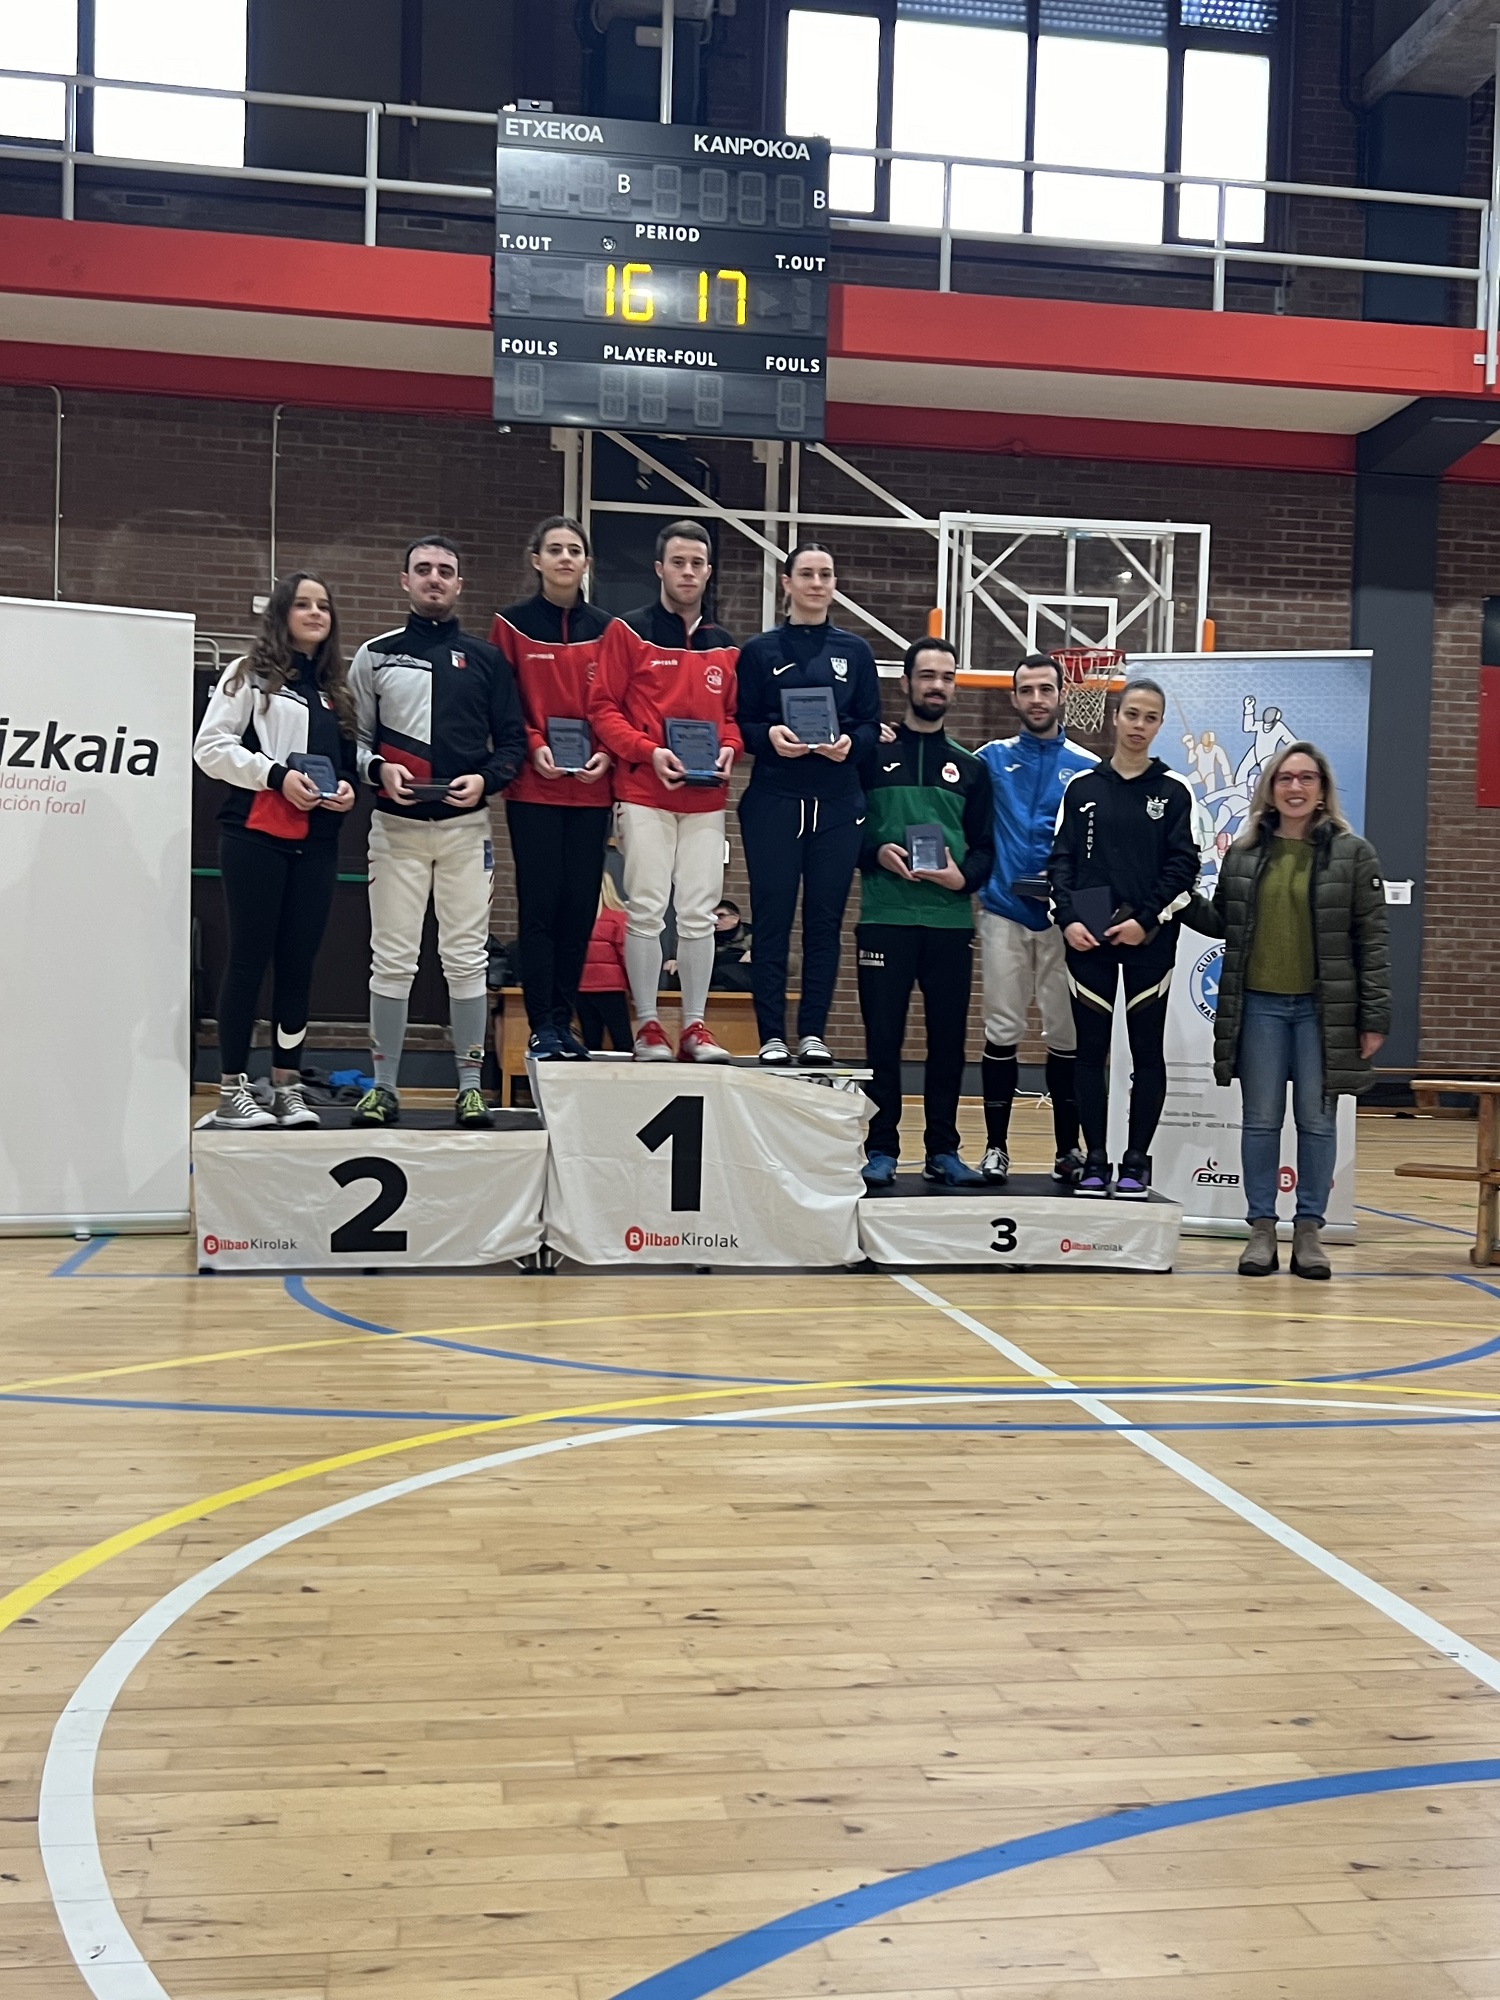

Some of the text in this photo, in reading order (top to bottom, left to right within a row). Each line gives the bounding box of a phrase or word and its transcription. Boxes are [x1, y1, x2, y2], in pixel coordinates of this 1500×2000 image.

[505, 117, 810, 161] ETXEKOA KANPOKOA
[617, 174, 631, 194] B
[813, 190, 826, 209] B
[499, 233, 552, 251] T.OUT
[635, 224, 700, 242] PERIOD
[775, 254, 826, 271] T.OUT
[605, 263, 747, 325] 16 17
[501, 338, 821, 373] FOULS PLAYER-FOUL FOULS
[0, 795, 86, 815] ción foral
[1197, 950, 1218, 973] CLUB
[636, 1095, 704, 1212] 1
[1197, 1173, 1240, 1185] EKFB
[329, 1156, 408, 1253] 2
[989, 1217, 1017, 1253] 3
